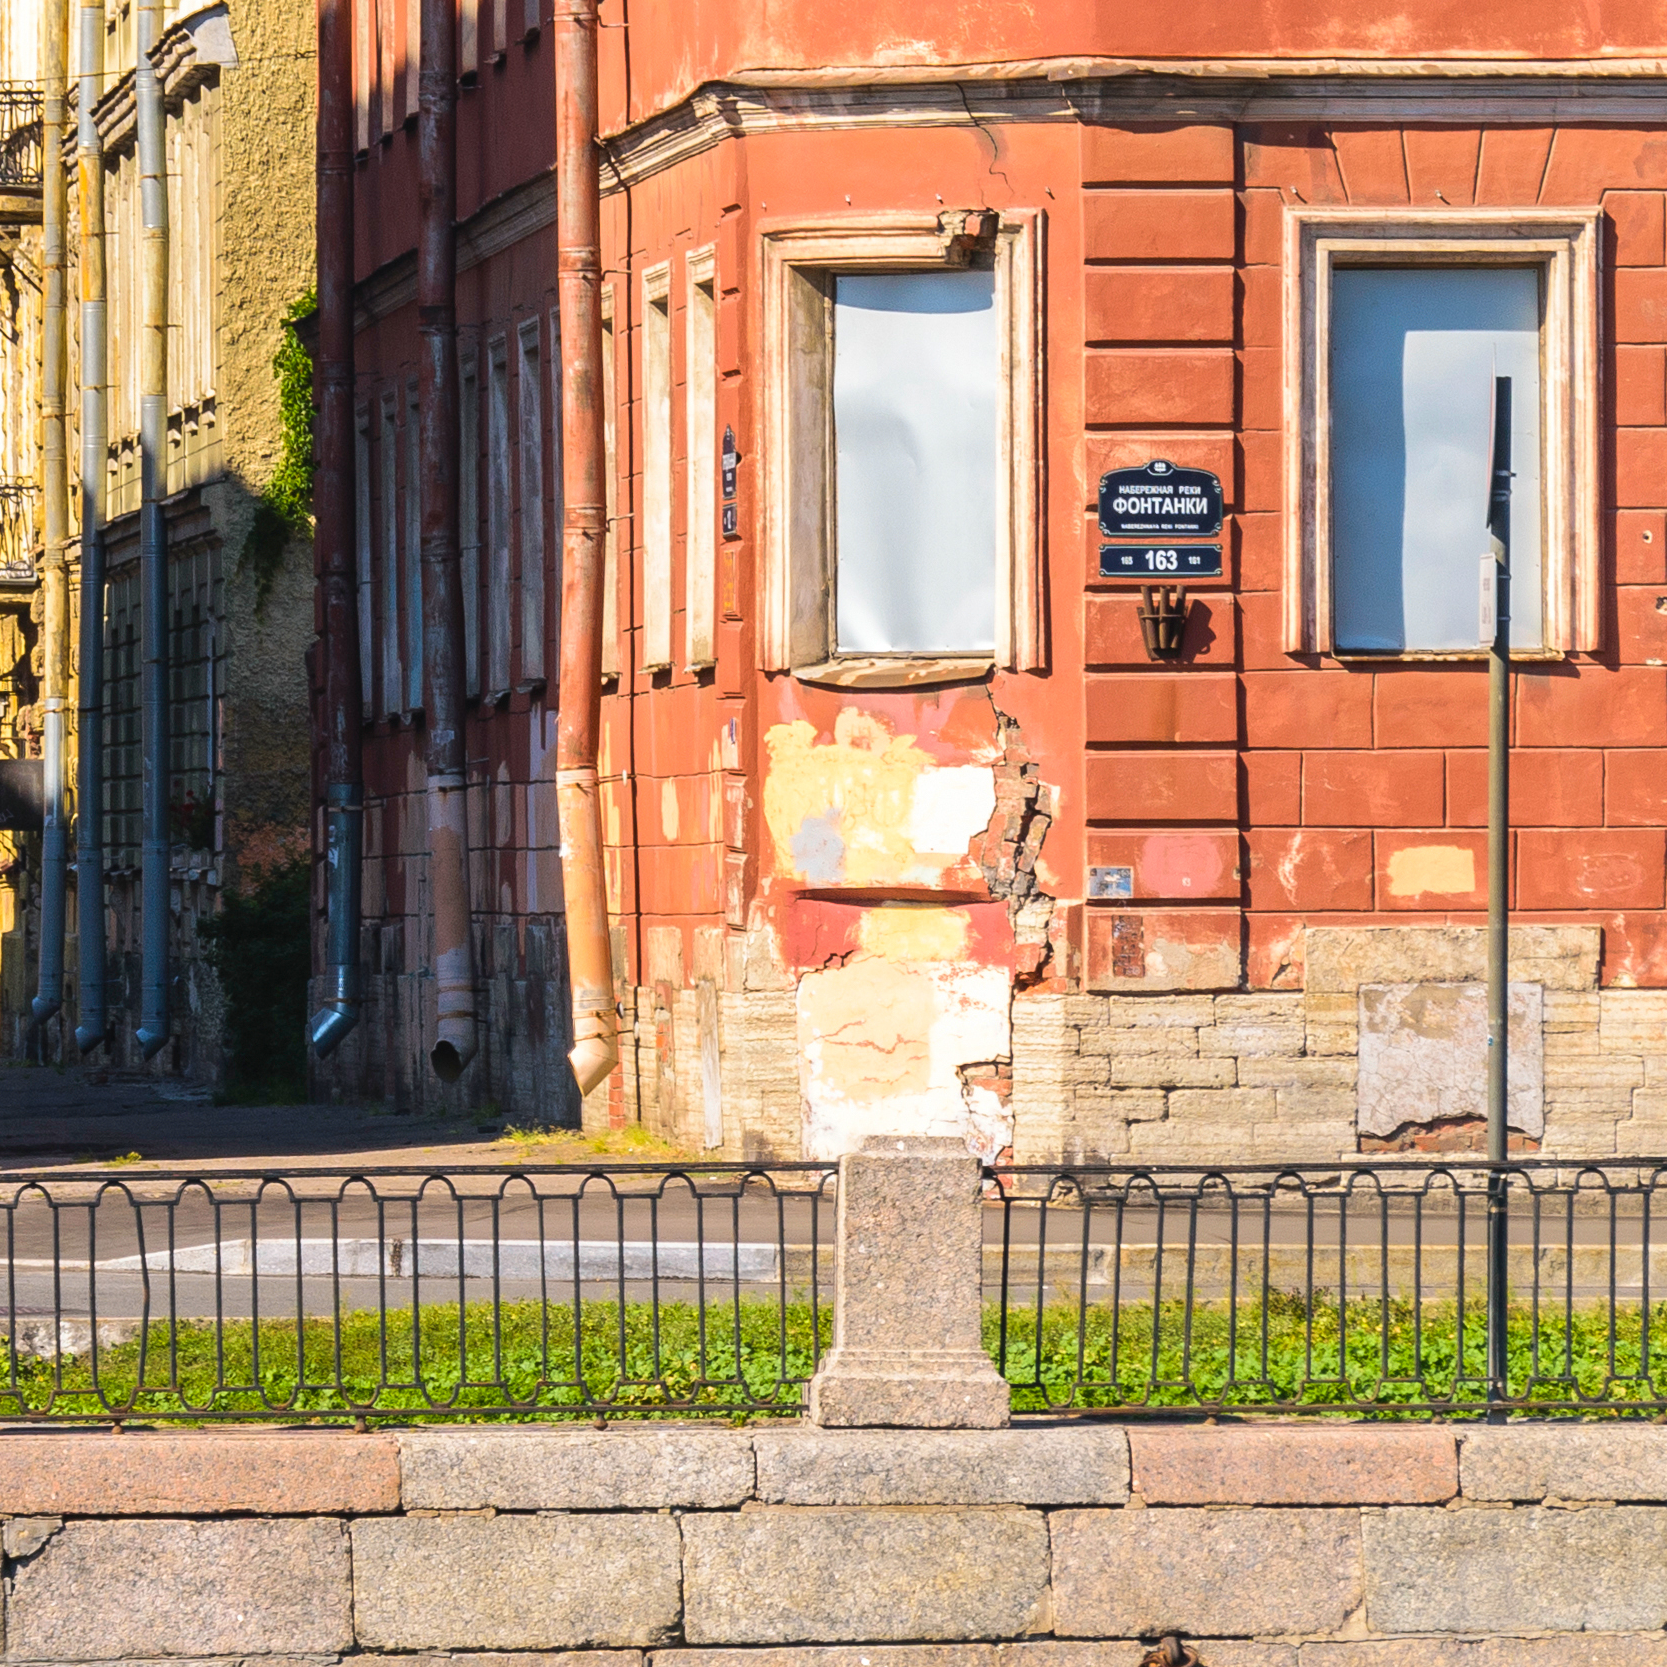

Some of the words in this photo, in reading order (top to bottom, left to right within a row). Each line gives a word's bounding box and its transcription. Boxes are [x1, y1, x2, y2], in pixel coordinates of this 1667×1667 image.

[1119, 485, 1174, 495] НАБЕРЕЖНАЯ
[1179, 486, 1201, 495] РЕКИ
[1113, 497, 1208, 515] ФОНТАНКИ
[1145, 550, 1178, 570] 163
